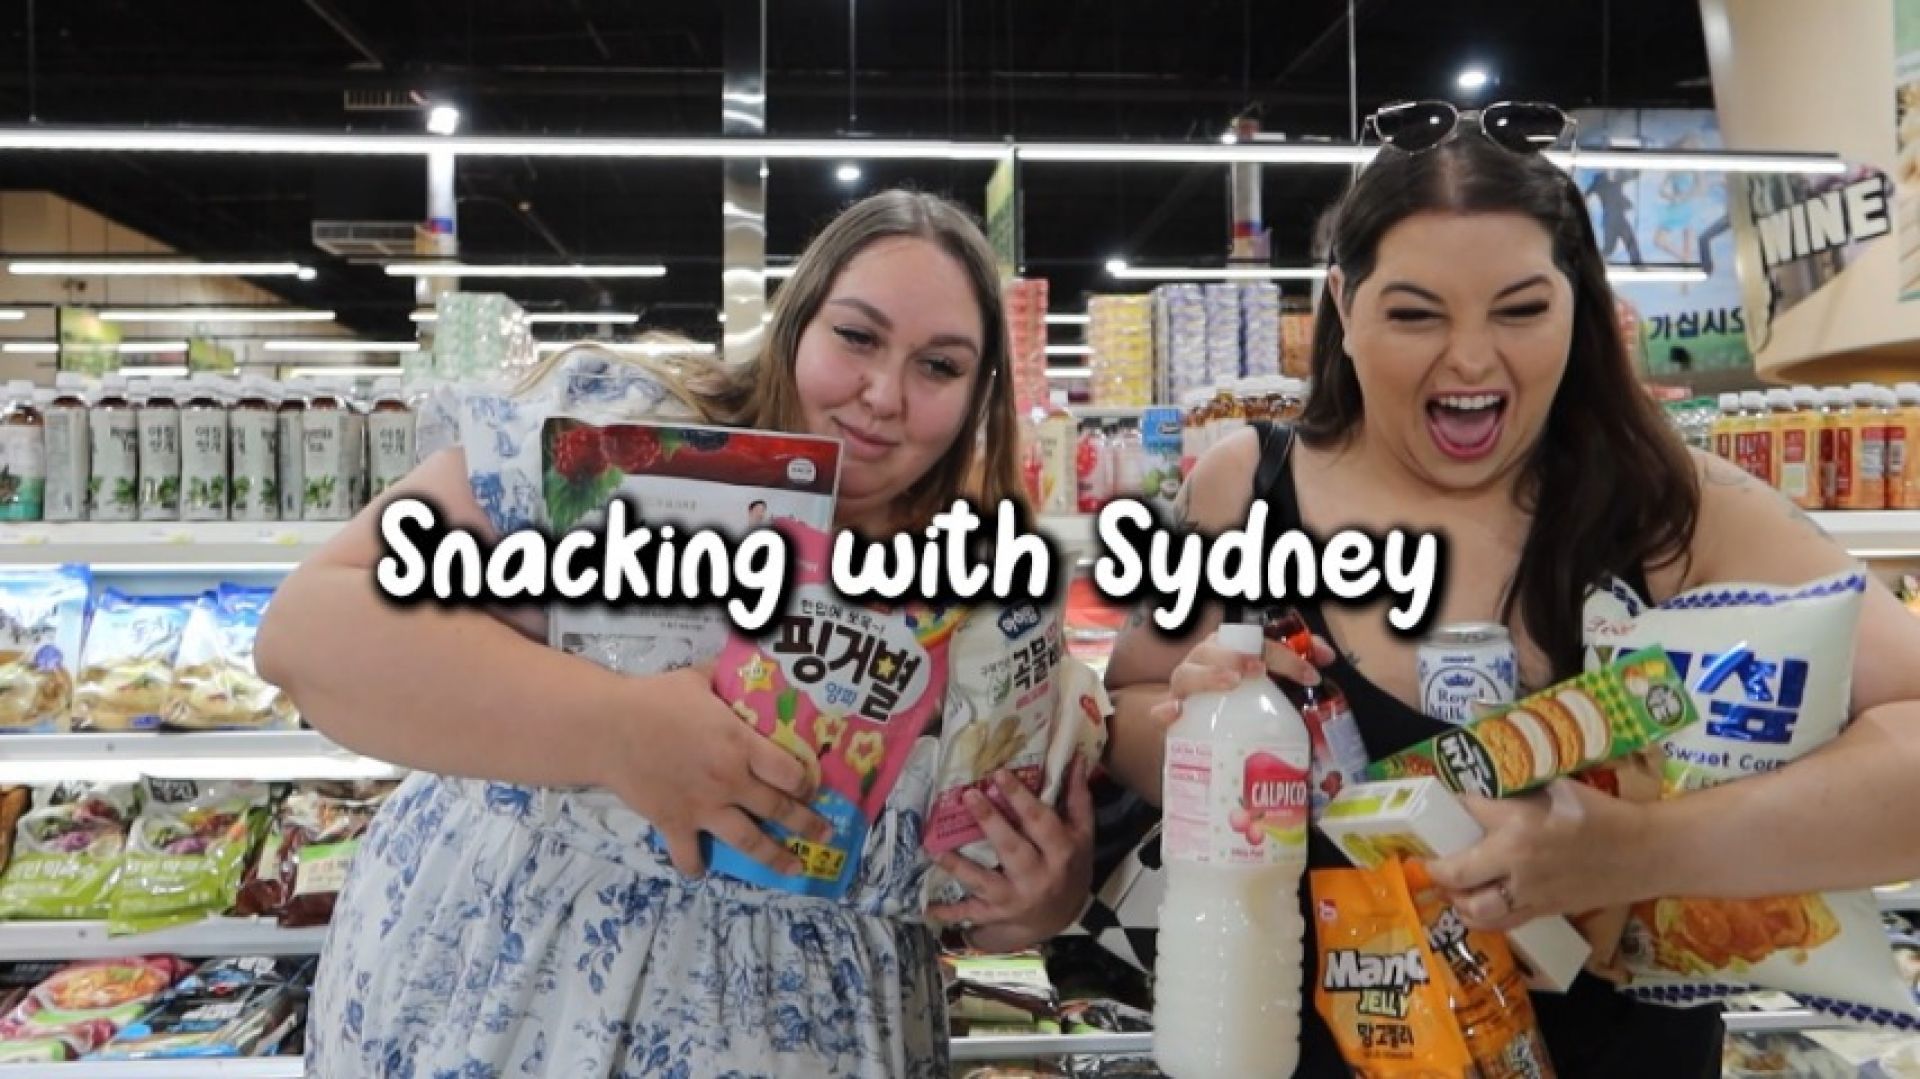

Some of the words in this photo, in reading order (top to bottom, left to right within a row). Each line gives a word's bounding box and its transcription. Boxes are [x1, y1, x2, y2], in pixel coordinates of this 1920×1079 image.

[1755, 172, 1892, 267] WINE
[1663, 740, 1730, 768] Sweet
[1739, 754, 1790, 773] Cor
[1251, 780, 1307, 808] CALPICO
